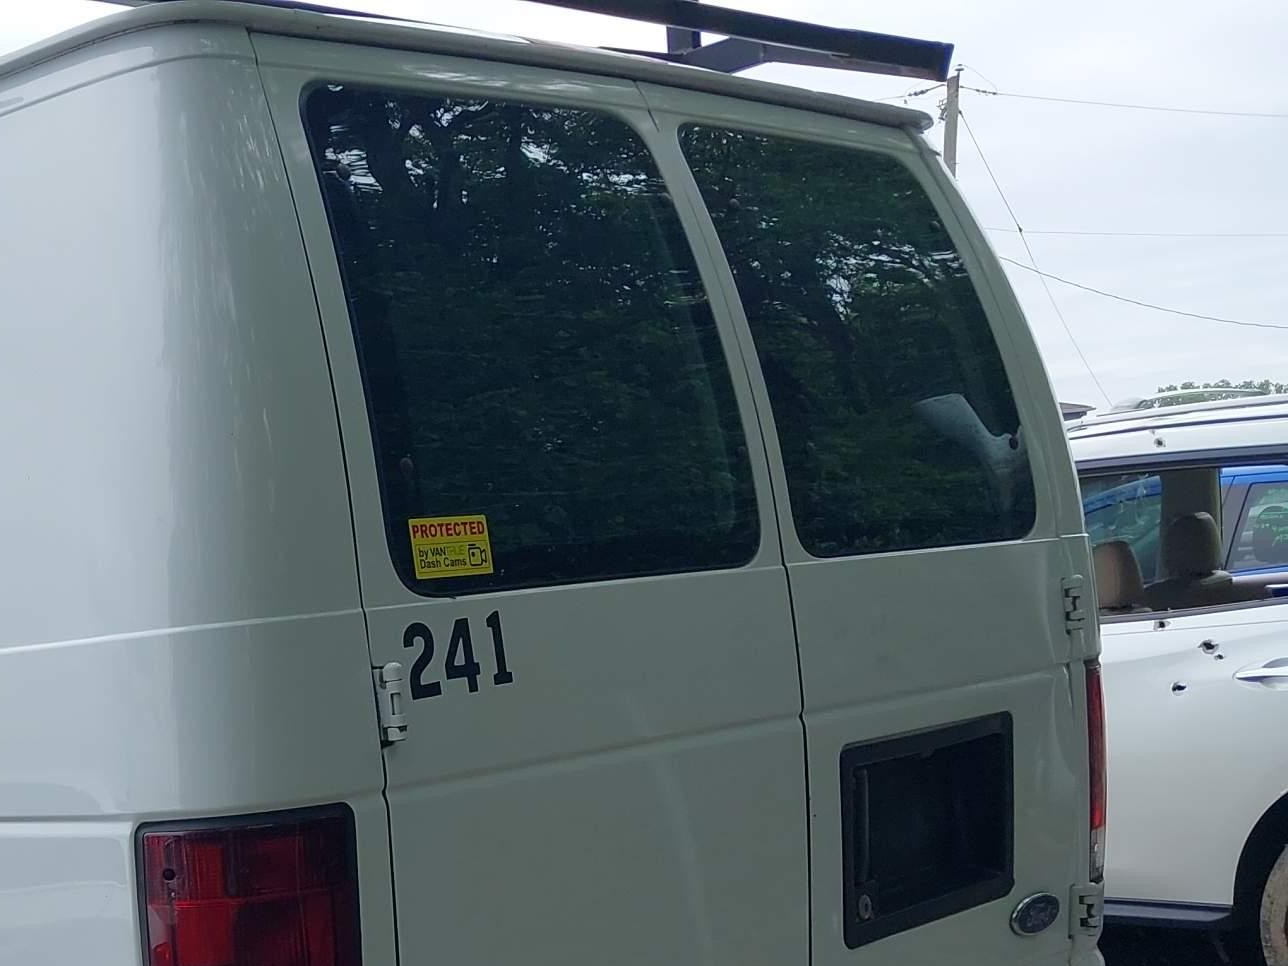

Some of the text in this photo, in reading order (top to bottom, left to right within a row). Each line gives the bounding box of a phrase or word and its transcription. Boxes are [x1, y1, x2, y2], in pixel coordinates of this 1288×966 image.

[411, 520, 485, 539] PROTECTED
[418, 547, 429, 560] by
[420, 556, 467, 569] Dash Cams
[402, 610, 513, 700] 241
